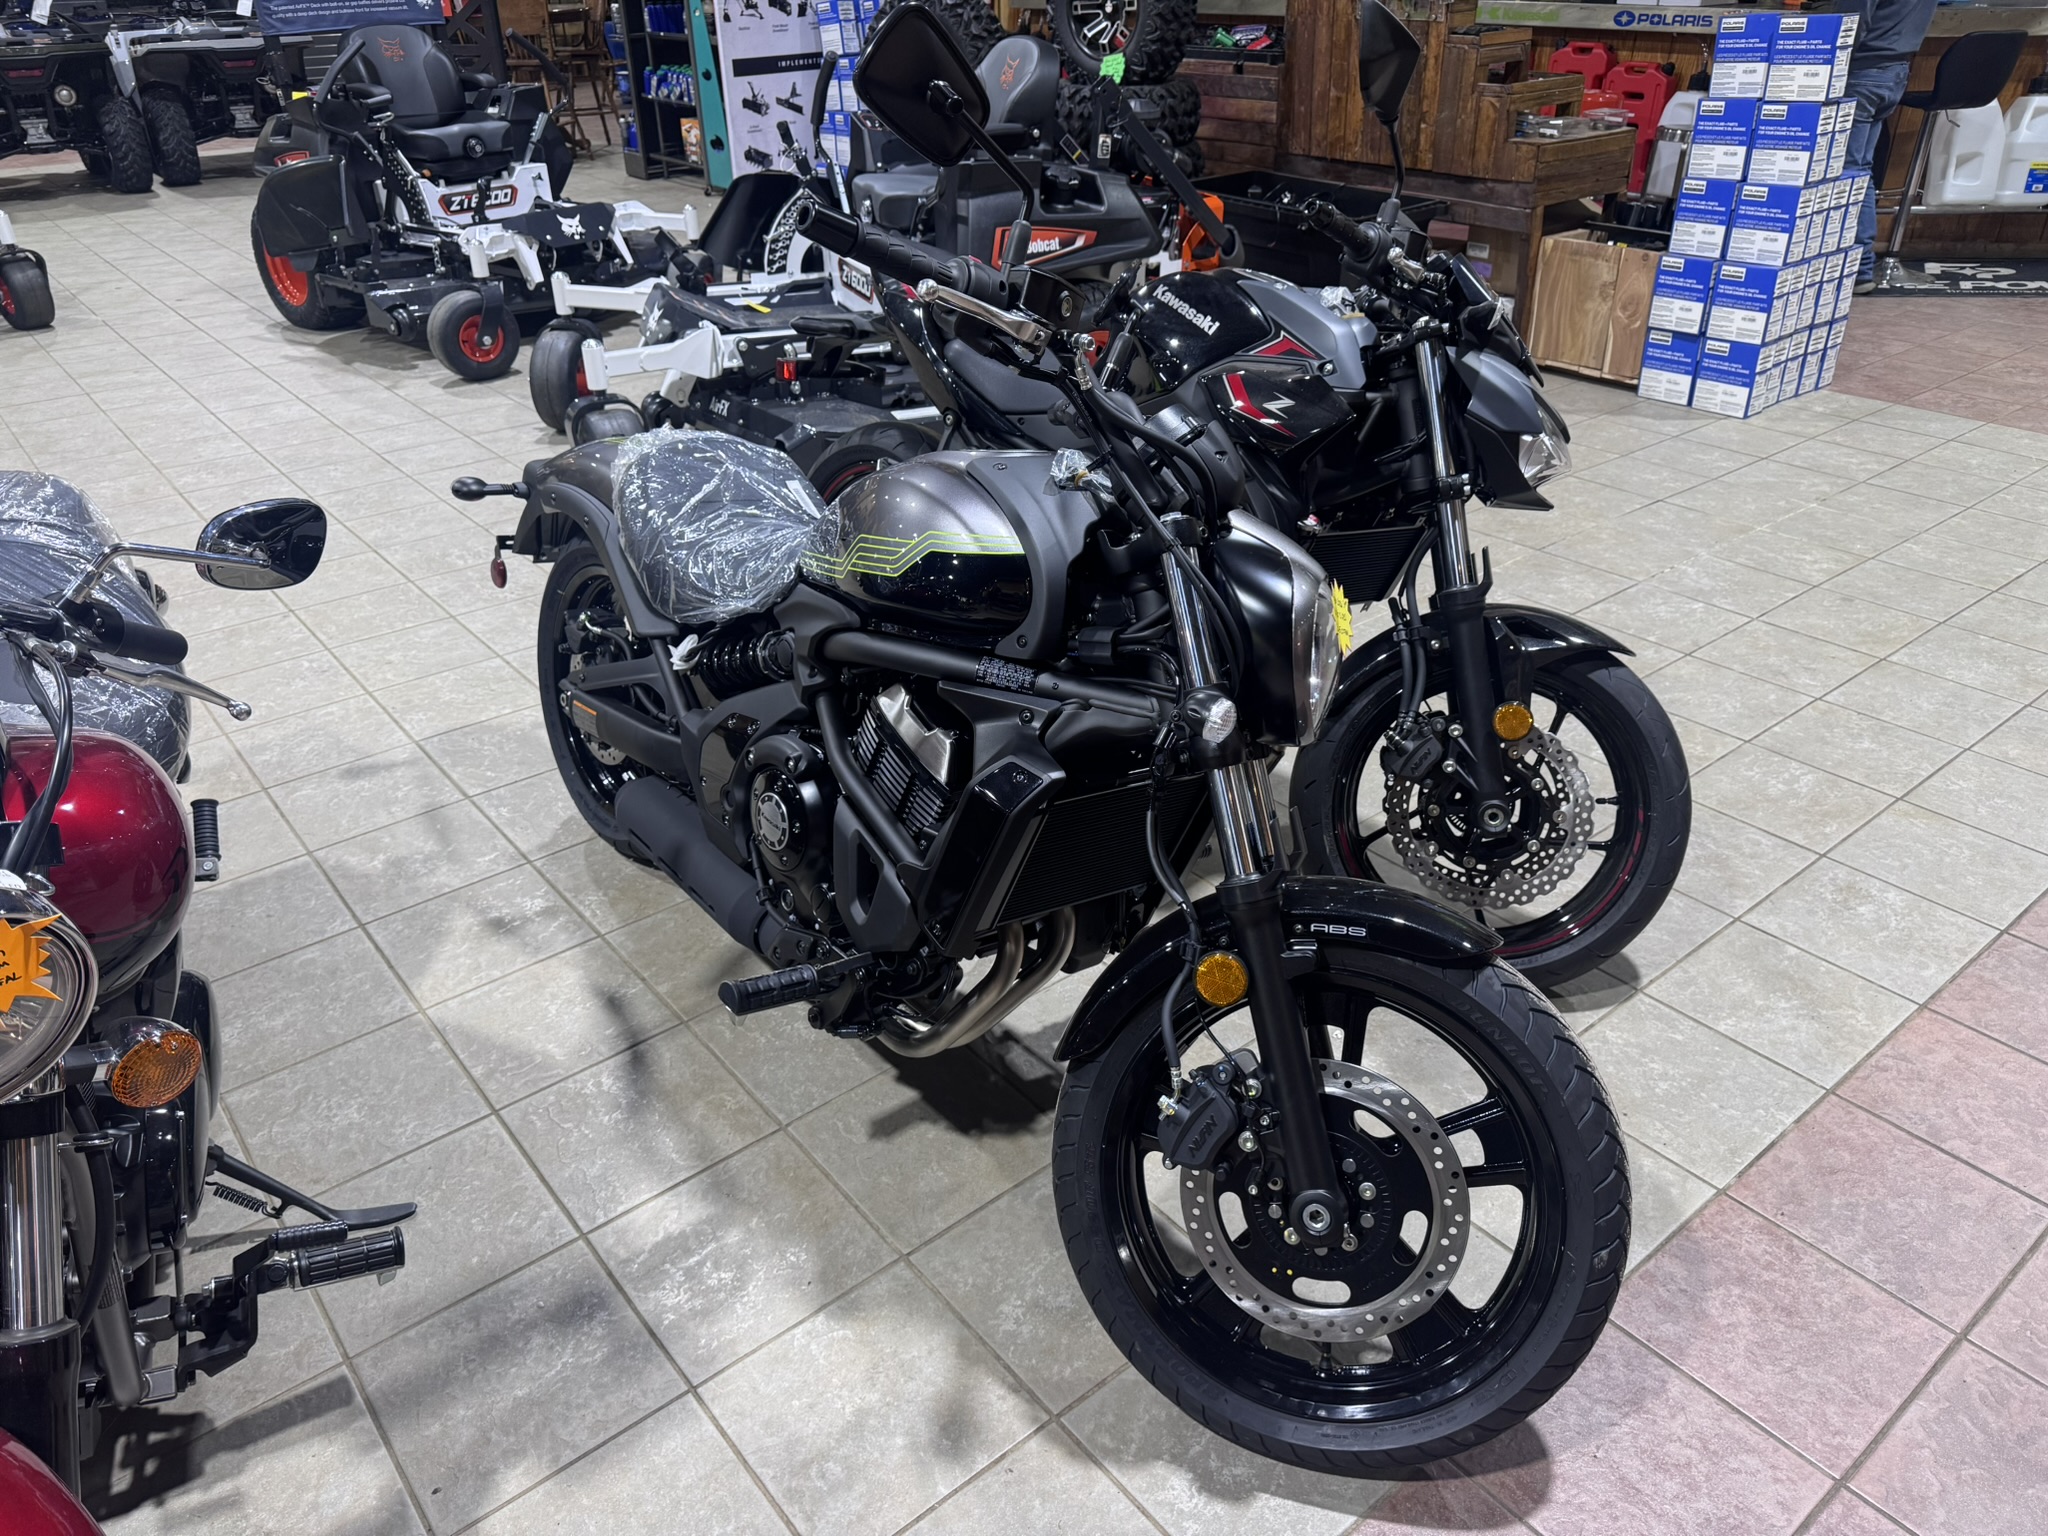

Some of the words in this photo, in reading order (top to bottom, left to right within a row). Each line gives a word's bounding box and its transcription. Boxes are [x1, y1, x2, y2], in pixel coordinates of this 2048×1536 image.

[1637, 13, 1713, 27] POLARIS
[449, 188, 512, 212] ZT600
[1152, 284, 1220, 336] Kawasaki
[1310, 923, 1367, 937] ABS
